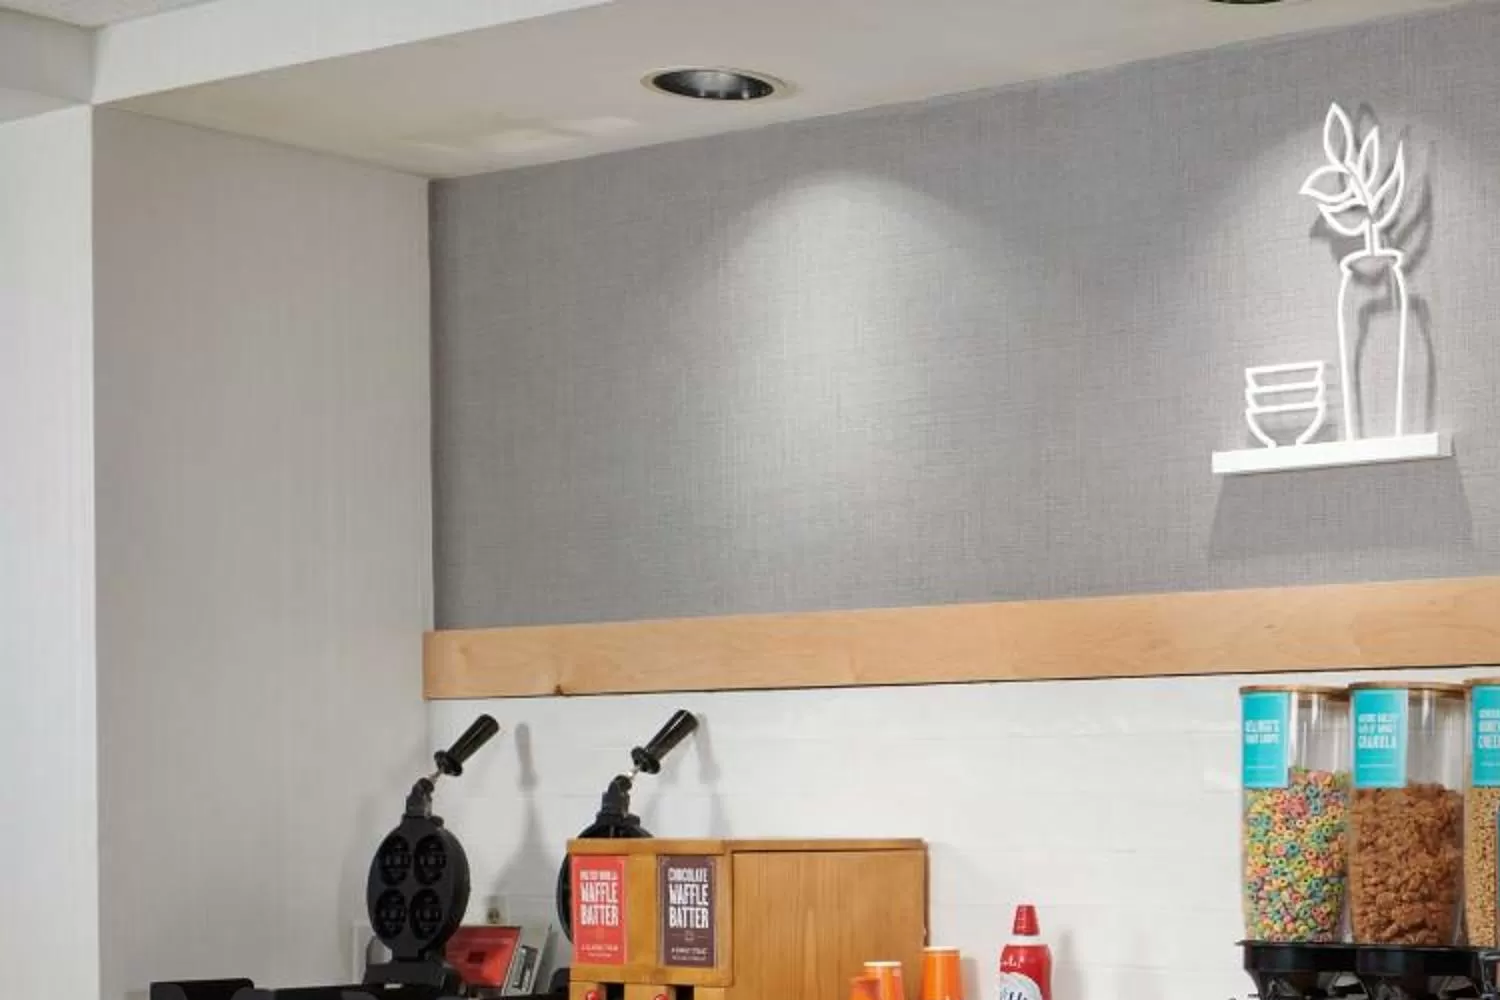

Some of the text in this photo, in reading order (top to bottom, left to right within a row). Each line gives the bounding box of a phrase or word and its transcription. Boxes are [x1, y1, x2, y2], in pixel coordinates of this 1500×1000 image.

[667, 867, 709, 883] CHOCOLATE
[580, 881, 619, 904] WAFFLE
[668, 883, 710, 906] WAFFLE
[580, 903, 620, 927] BATTER
[668, 906, 710, 929] BATTER
